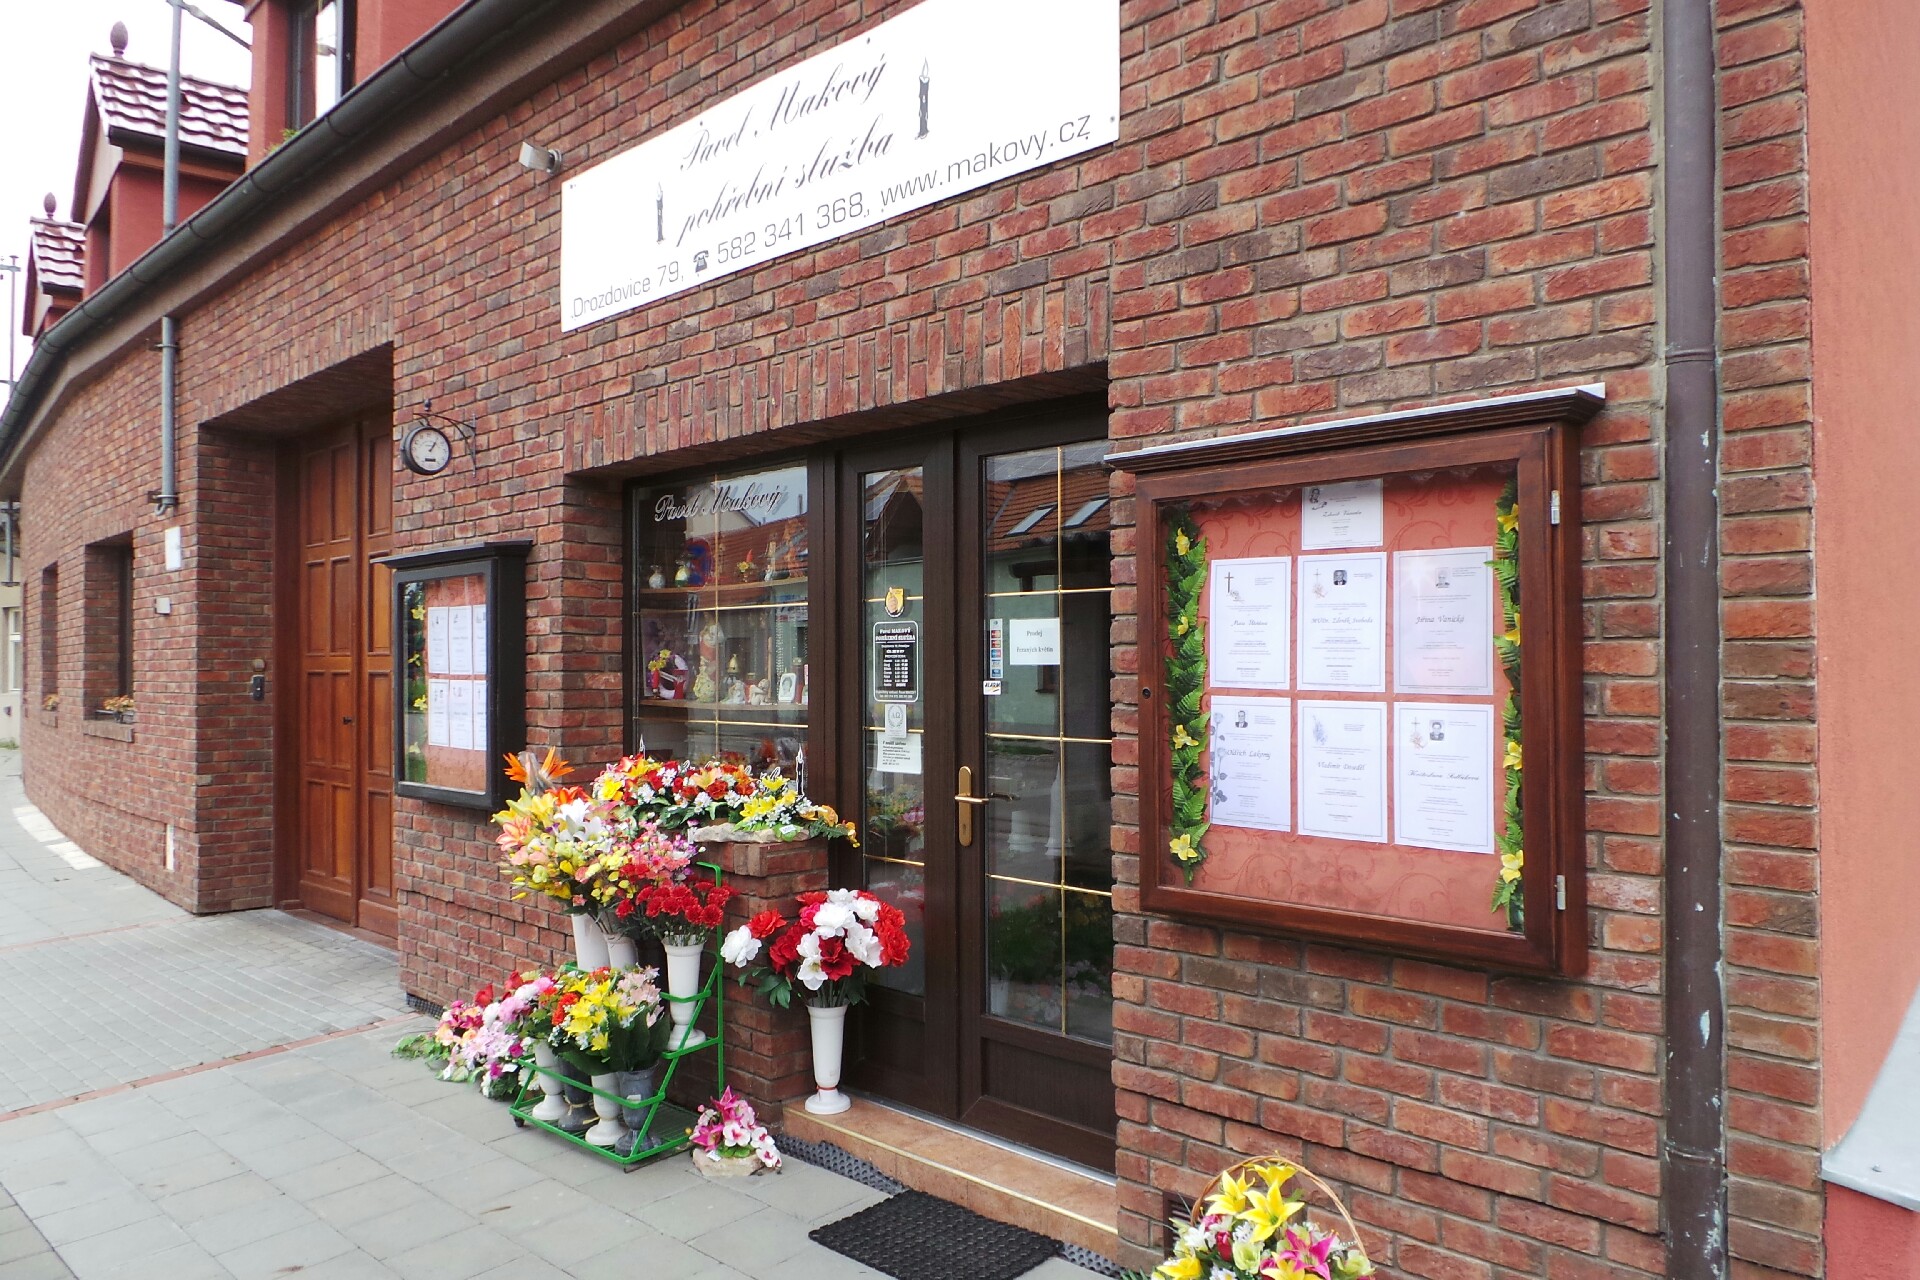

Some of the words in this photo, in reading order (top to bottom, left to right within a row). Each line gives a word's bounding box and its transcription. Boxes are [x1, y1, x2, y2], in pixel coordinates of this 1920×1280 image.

[680, 104, 756, 170] Pavel
[754, 53, 887, 137] Makový
[573, 277, 651, 319] Drozdovice
[657, 261, 684, 287] 79,
[717, 231, 756, 265] 582
[764, 212, 804, 248] 341
[880, 114, 1092, 208] www.makovy.cz
[676, 162, 788, 247] pohřební
[795, 113, 894, 189] služba
[654, 494, 702, 522] Pavel
[702, 482, 781, 515] Makový
